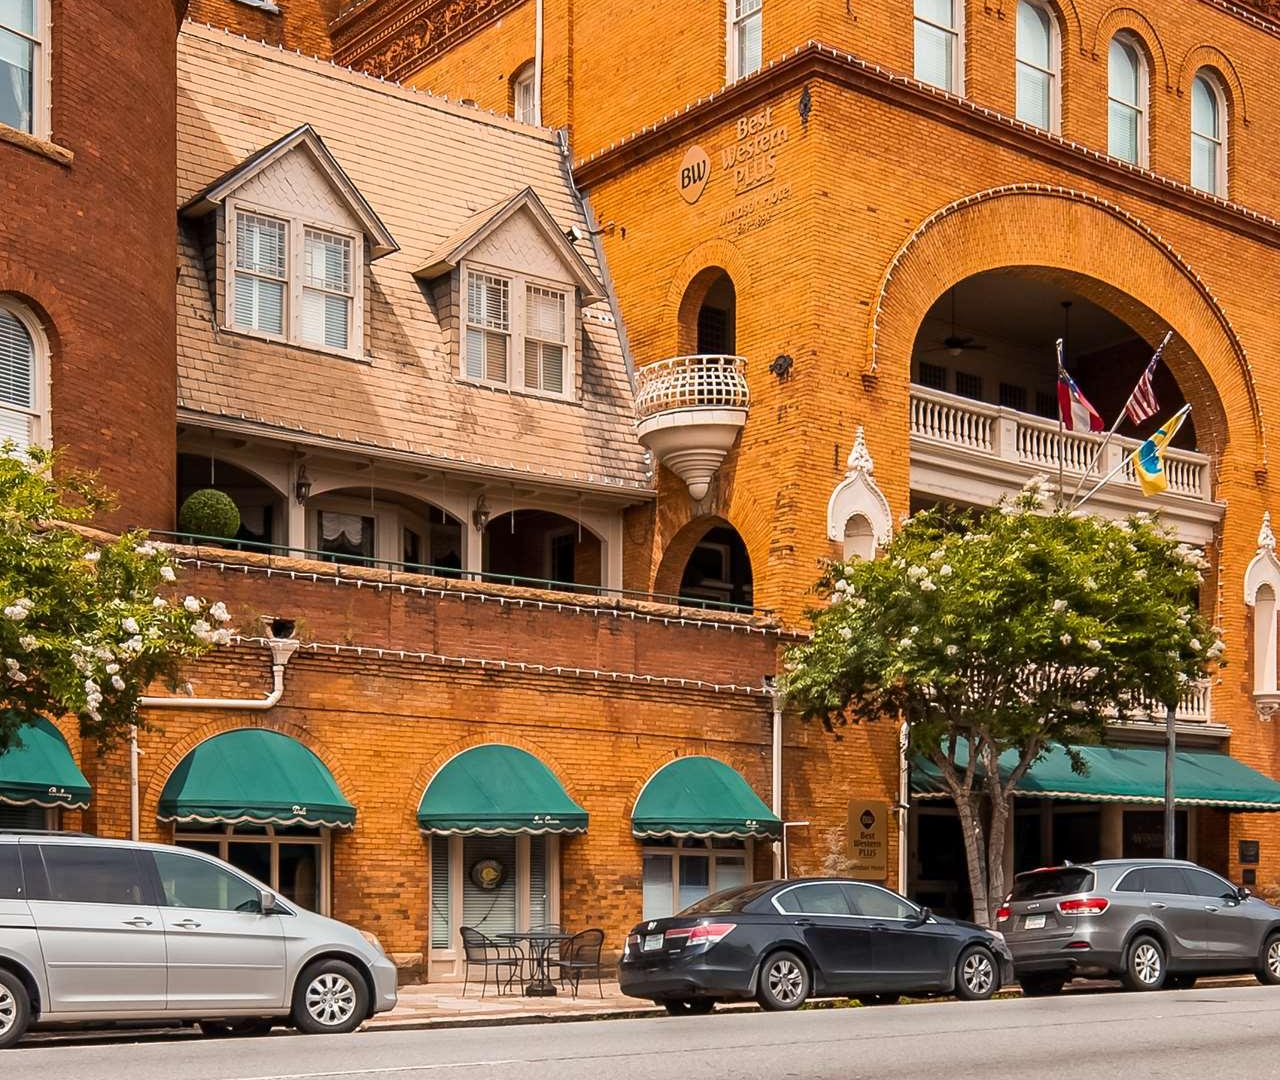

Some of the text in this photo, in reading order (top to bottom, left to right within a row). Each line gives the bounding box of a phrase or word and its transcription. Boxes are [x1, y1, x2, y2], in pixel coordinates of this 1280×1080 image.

[737, 107, 773, 141] Best
[722, 127, 788, 170] Western
[682, 160, 706, 189] BW
[734, 151, 776, 188] PLUS
